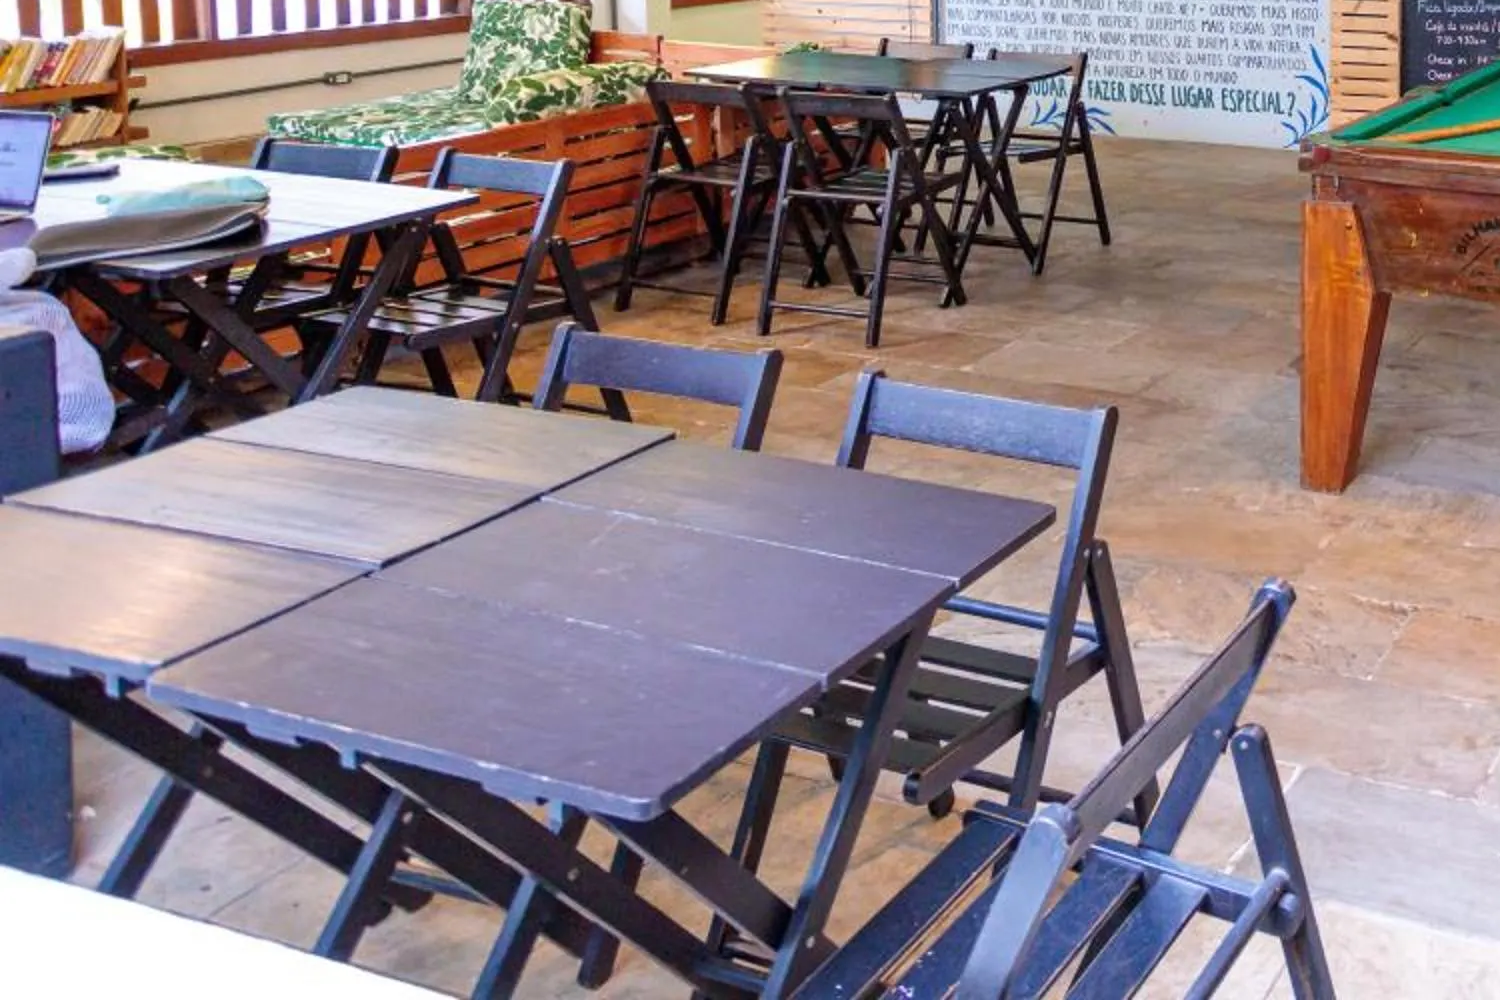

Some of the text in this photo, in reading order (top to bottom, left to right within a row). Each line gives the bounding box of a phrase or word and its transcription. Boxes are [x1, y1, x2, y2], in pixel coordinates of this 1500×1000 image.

[1028, 78, 1068, 99] JUDAR
[1087, 80, 1125, 101] FAZER
[1129, 83, 1167, 106] DESSE
[1171, 85, 1215, 109] LUGAR
